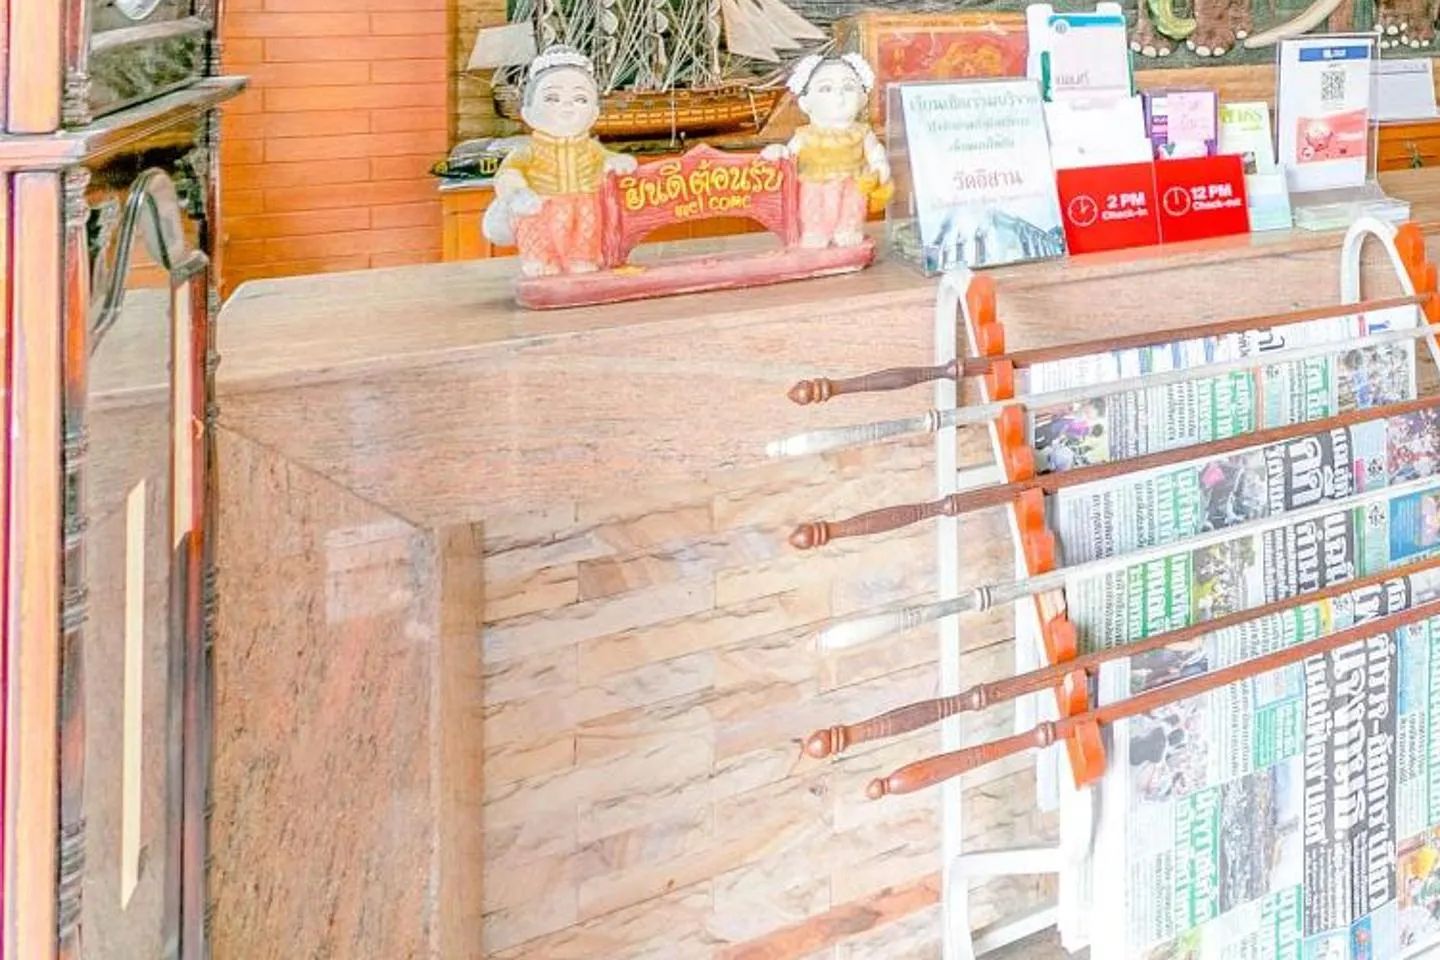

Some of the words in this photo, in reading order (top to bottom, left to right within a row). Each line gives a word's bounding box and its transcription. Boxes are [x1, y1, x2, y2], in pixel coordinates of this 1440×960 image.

[619, 159, 783, 210] ยินดีต้อนรับ
[1191, 186, 1206, 200] 12
[1208, 183, 1233, 198] PM
[1106, 195, 1118, 209] 2
[1120, 192, 1146, 207] PM
